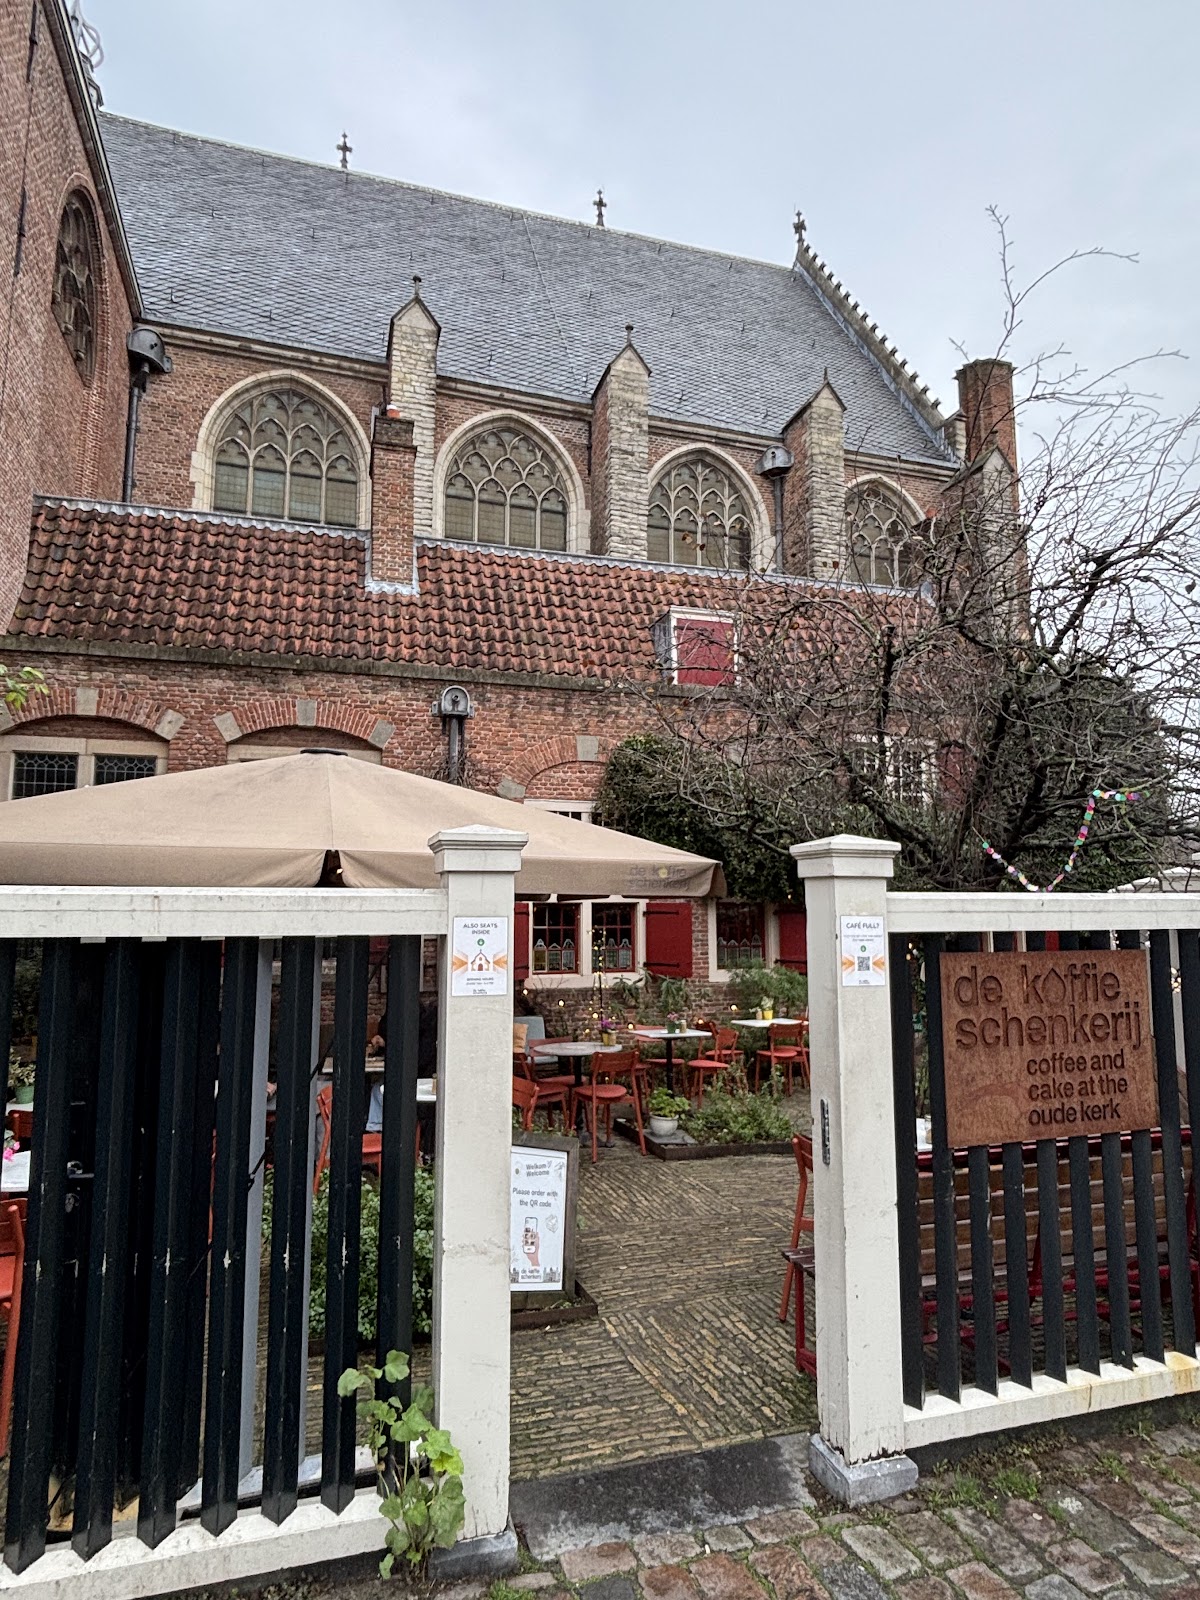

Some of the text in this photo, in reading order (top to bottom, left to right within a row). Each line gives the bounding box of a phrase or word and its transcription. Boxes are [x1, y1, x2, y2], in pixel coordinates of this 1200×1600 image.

[954, 962, 1121, 1007] de koffie
[955, 1001, 1142, 1049] schenkerij
[1026, 1049, 1125, 1076] coffee and
[1028, 1074, 1128, 1101] cake at the
[1028, 1098, 1121, 1126] oude kerk
[512, 1187, 530, 1196] Please
[530, 1200, 538, 1208] QR
